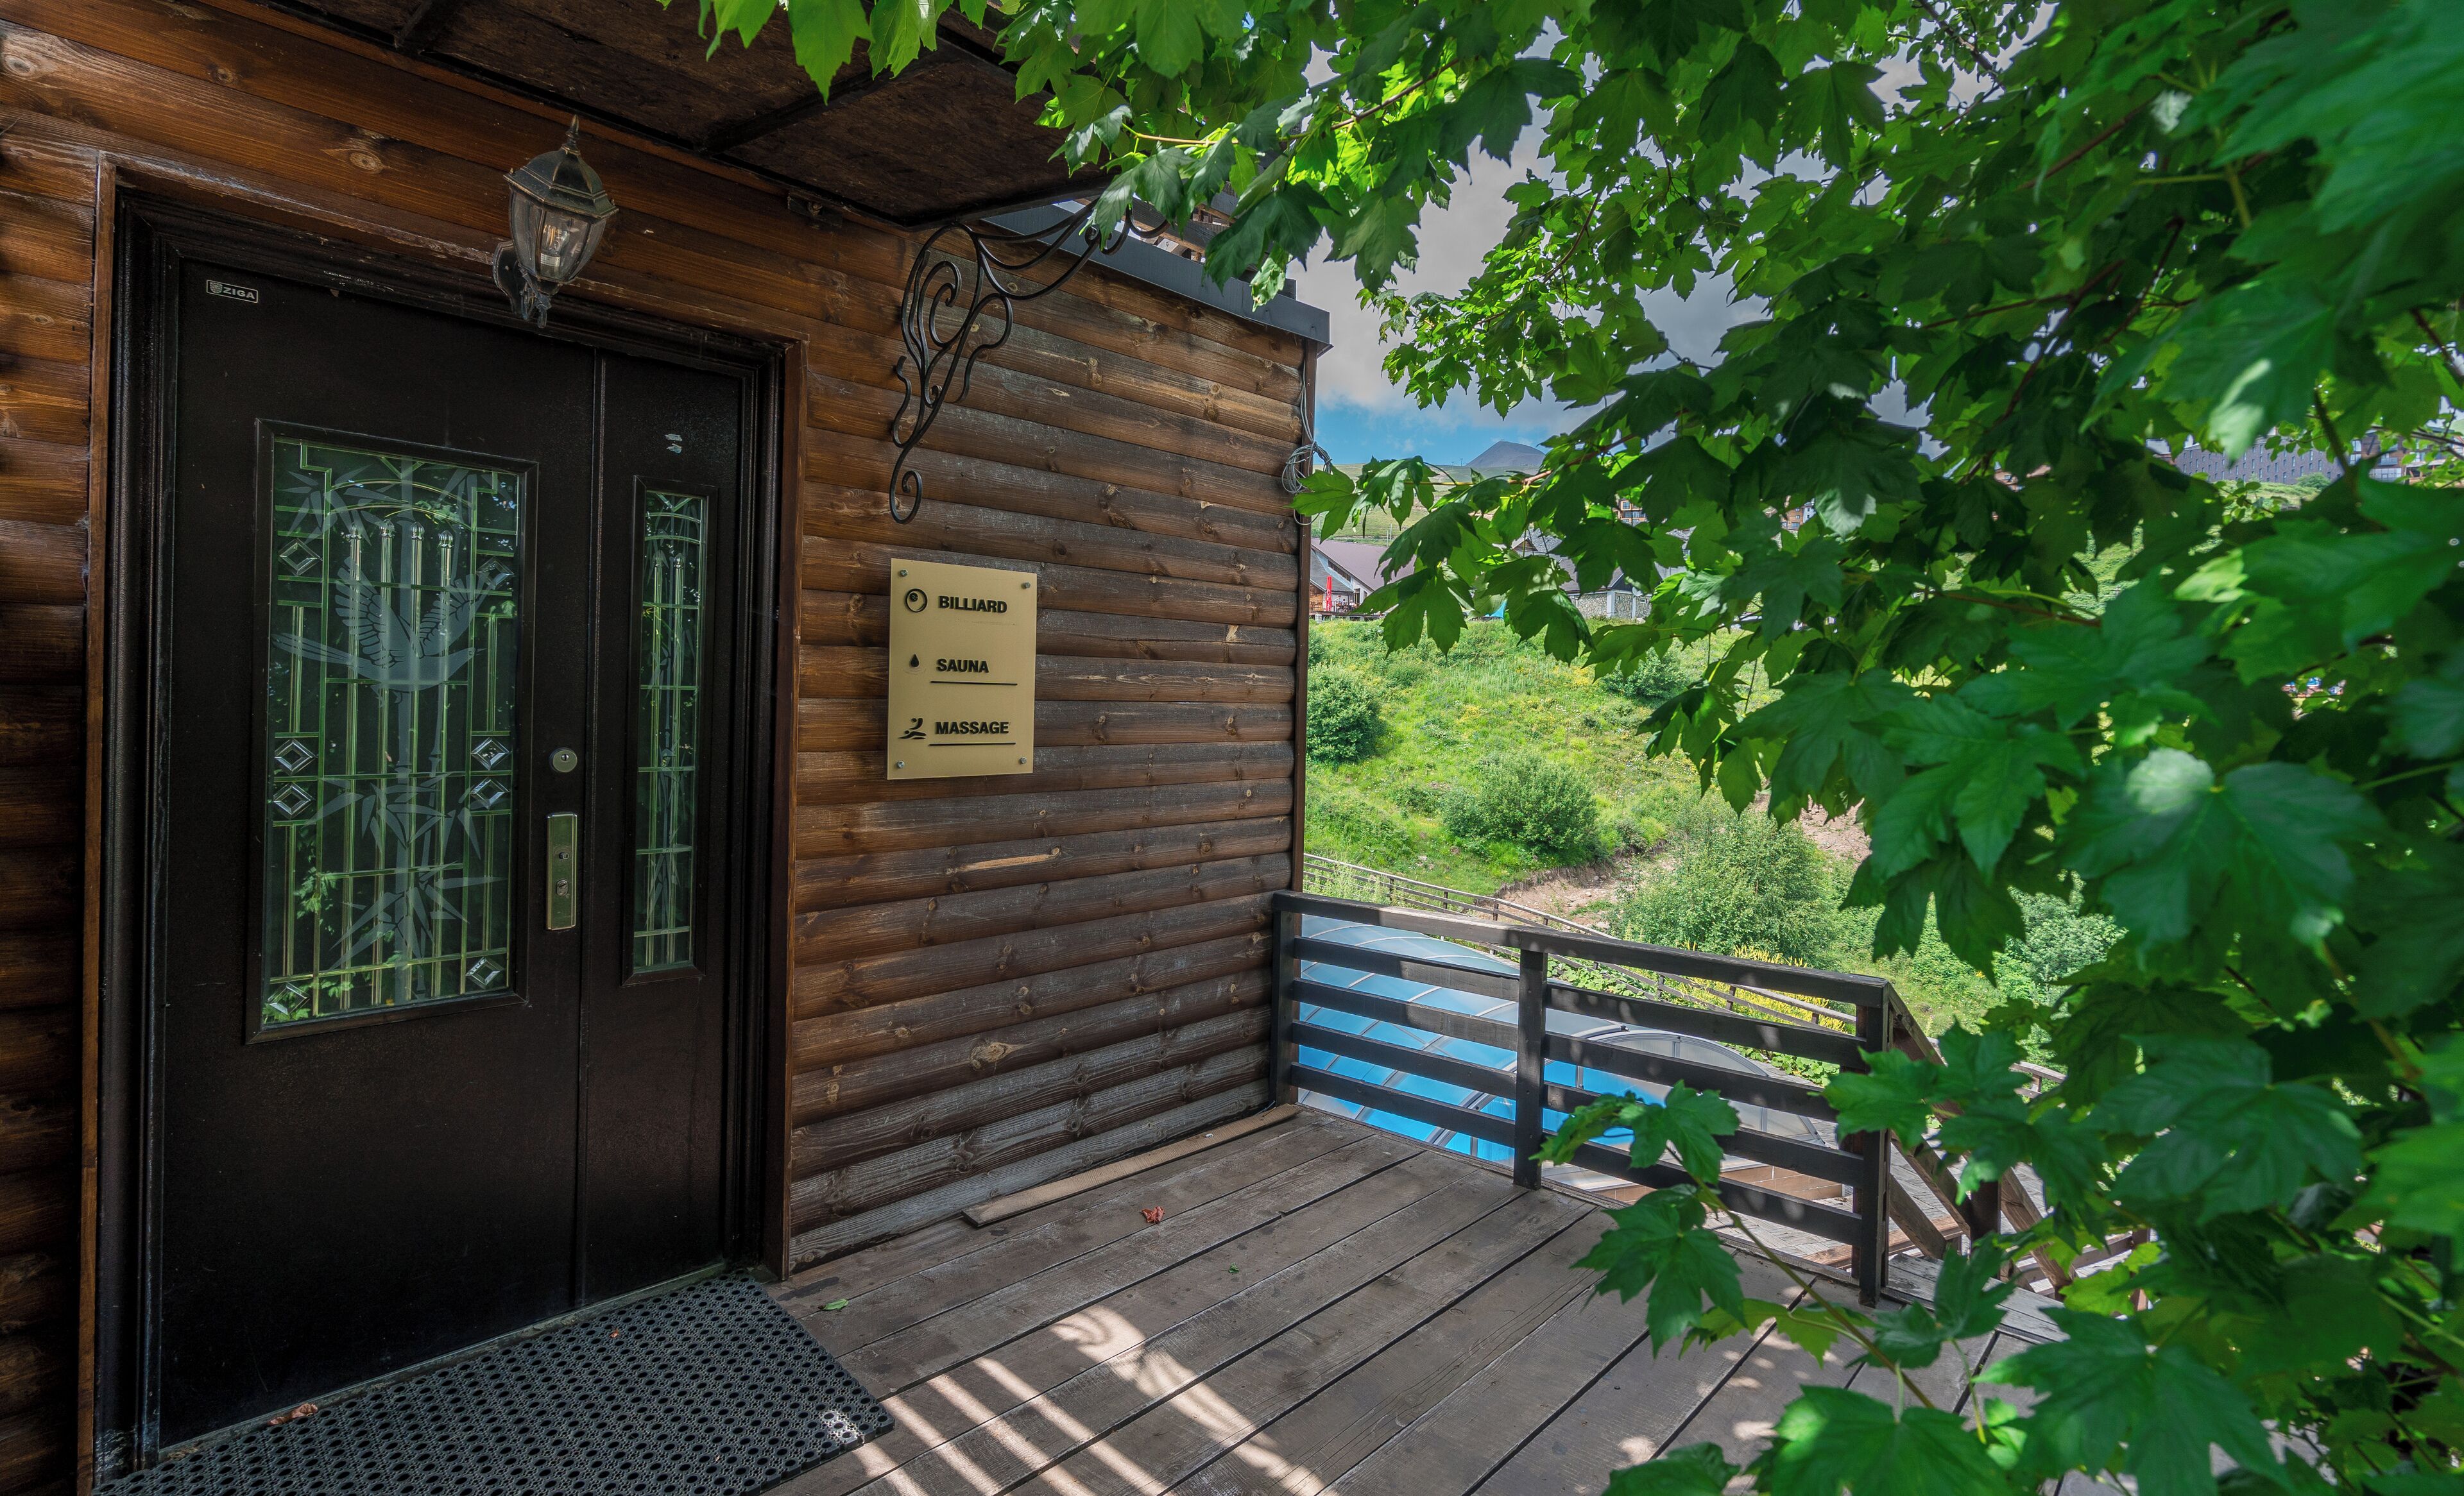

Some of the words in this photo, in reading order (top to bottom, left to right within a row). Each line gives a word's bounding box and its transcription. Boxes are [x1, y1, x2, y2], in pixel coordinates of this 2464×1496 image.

[223, 287, 255, 299] ZIGA
[939, 595, 1007, 613] BILLIARD
[936, 658, 989, 673] SAUNA
[935, 721, 1009, 735] MASSAGE
